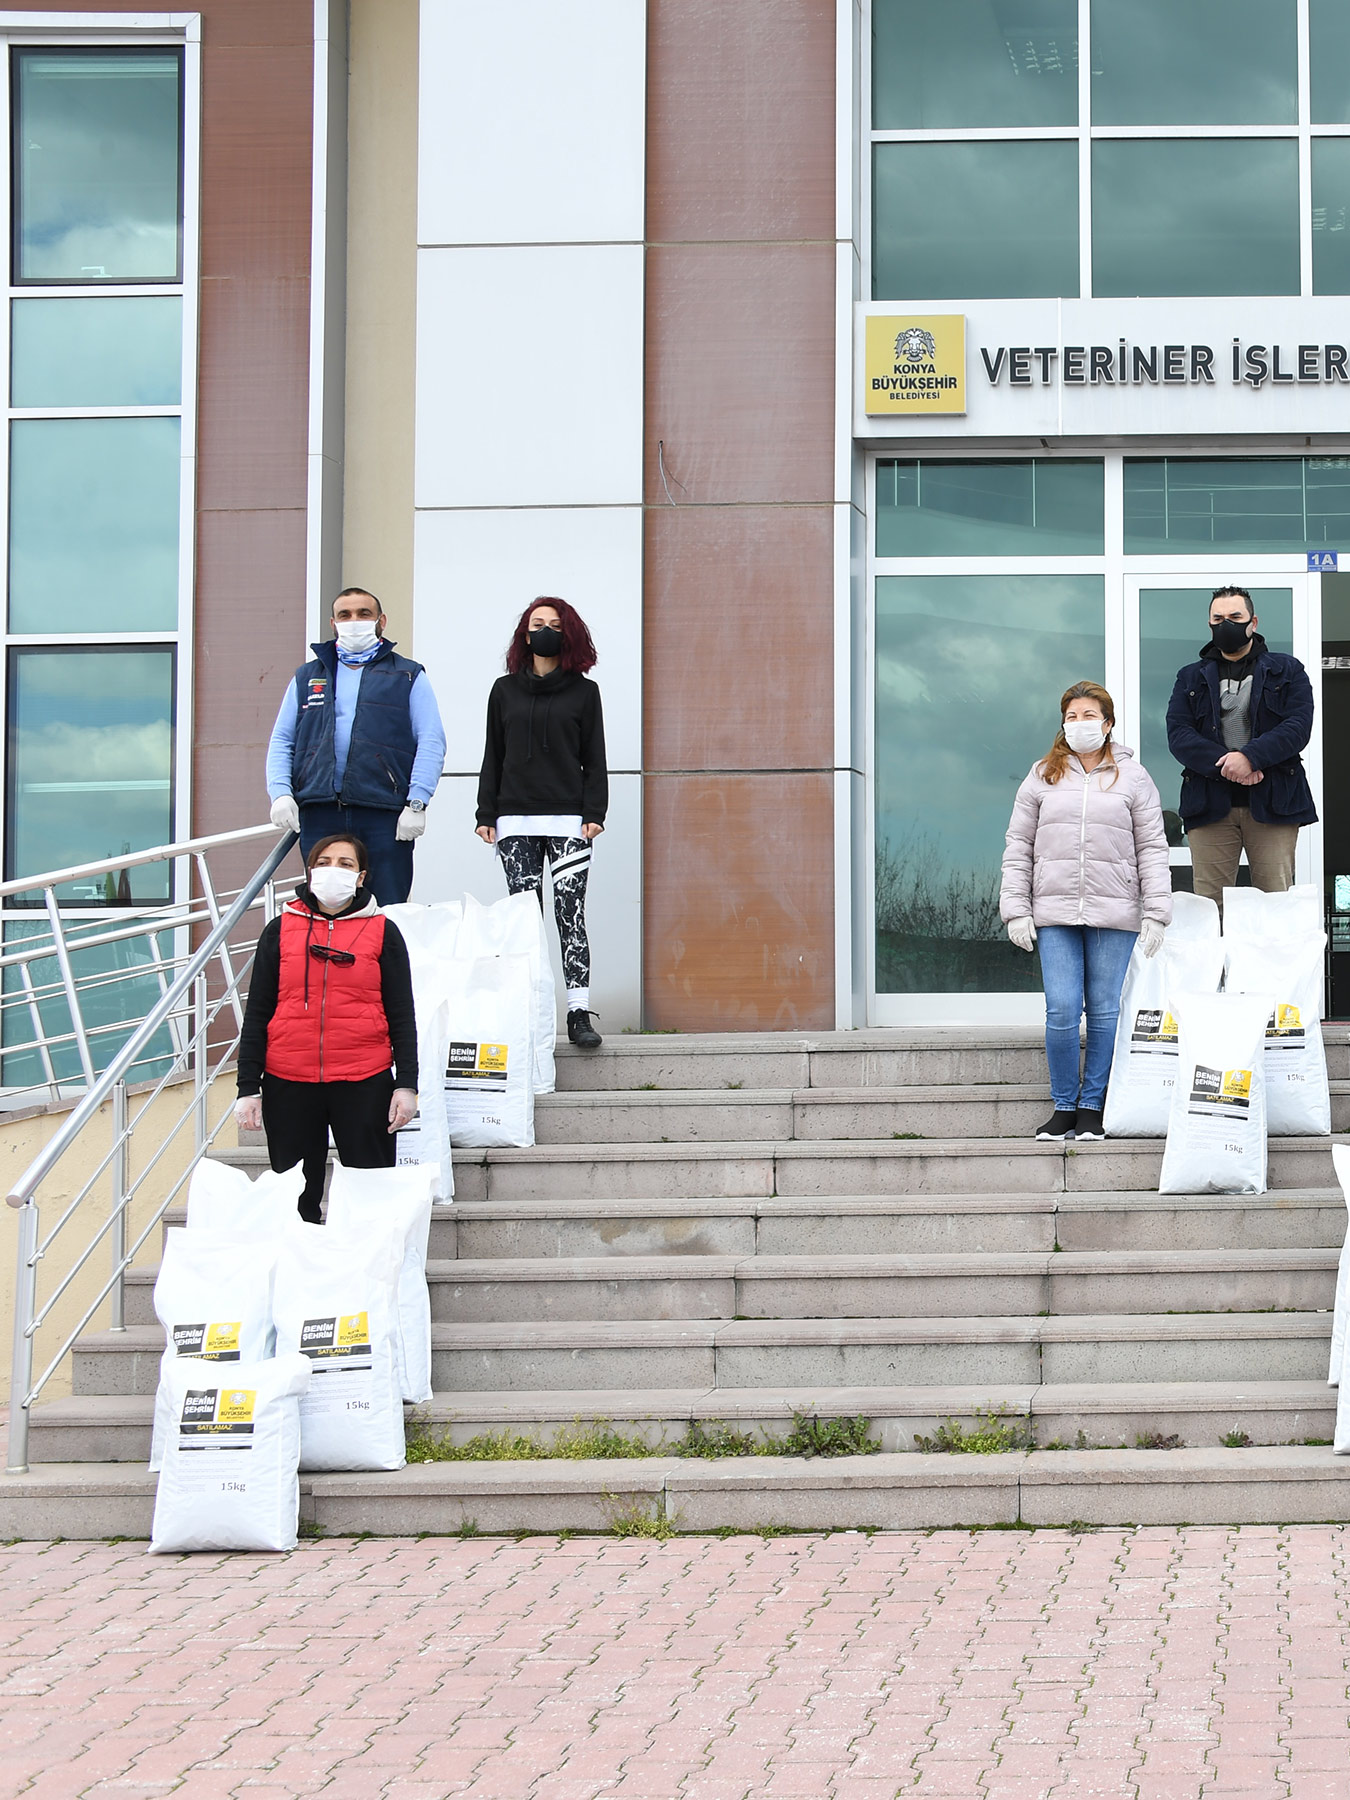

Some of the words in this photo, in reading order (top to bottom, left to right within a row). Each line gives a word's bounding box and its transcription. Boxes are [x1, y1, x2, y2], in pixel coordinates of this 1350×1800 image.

[980, 337, 1216, 386] VETERİNER
[893, 364, 936, 374] KONYA
[872, 374, 957, 391] BÜYÜKŞEHİR
[889, 390, 940, 400] BELEDİYESİ
[1311, 553, 1334, 565] 1A
[1195, 1071, 1220, 1082] BENİM
[482, 1116, 501, 1125] 15kg
[1224, 1144, 1243, 1154] 15kg
[304, 1323, 333, 1333] BENİM
[174, 1329, 203, 1339] BENİM
[302, 1331, 332, 1341] ŞEHRİM
[186, 1396, 215, 1405] BENİM
[346, 1401, 370, 1410] 15kg
[184, 1405, 214, 1415] ŞEHRİM
[221, 1482, 246, 1492] 15kg
